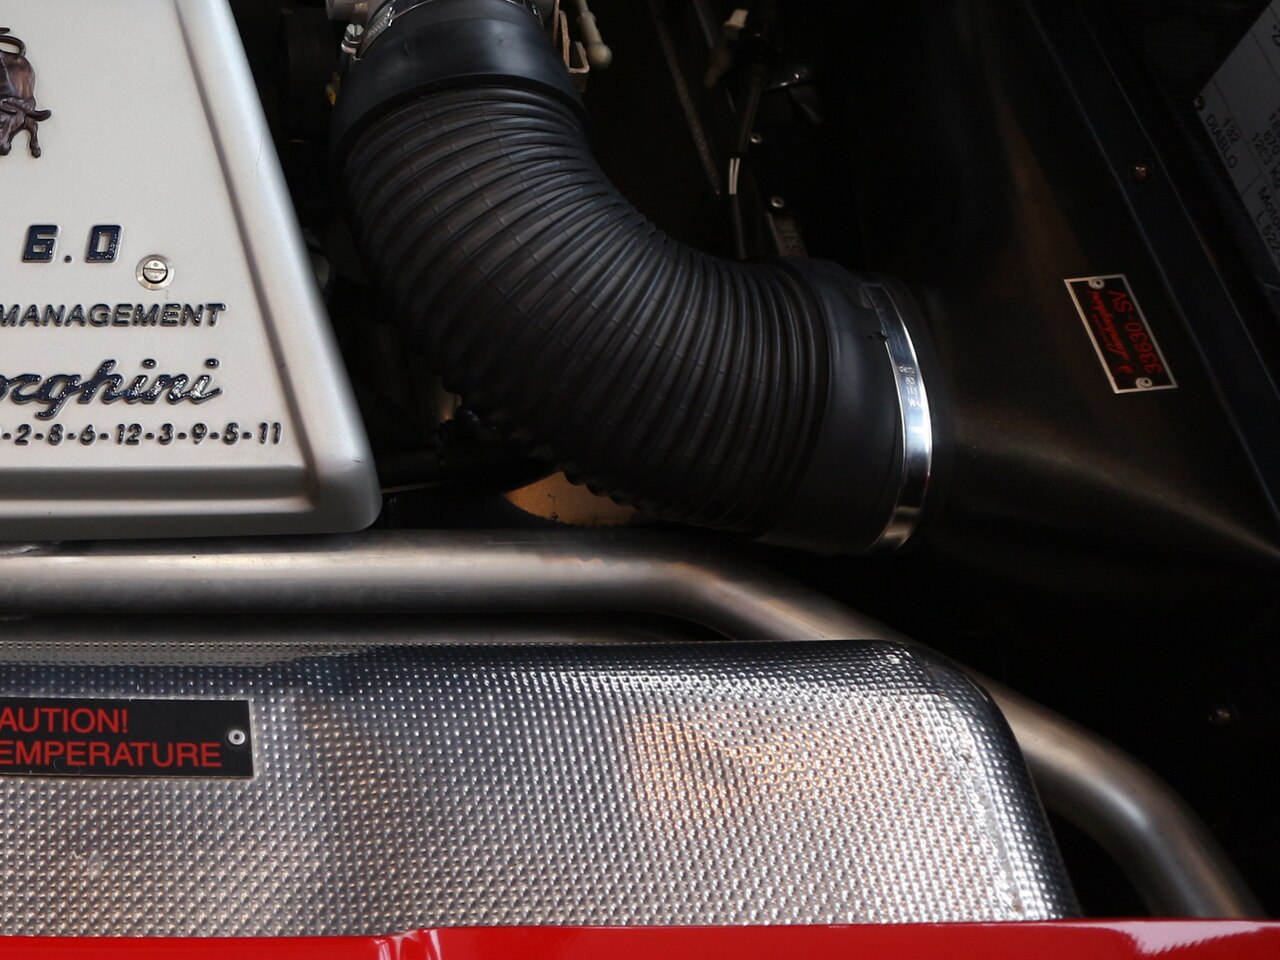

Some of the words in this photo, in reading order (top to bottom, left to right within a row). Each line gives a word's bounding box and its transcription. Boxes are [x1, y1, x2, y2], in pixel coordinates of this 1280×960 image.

[1206, 114, 1237, 168] DIABLO
[1223, 118, 1240, 145] 132
[21, 223, 123, 264] 6.0
